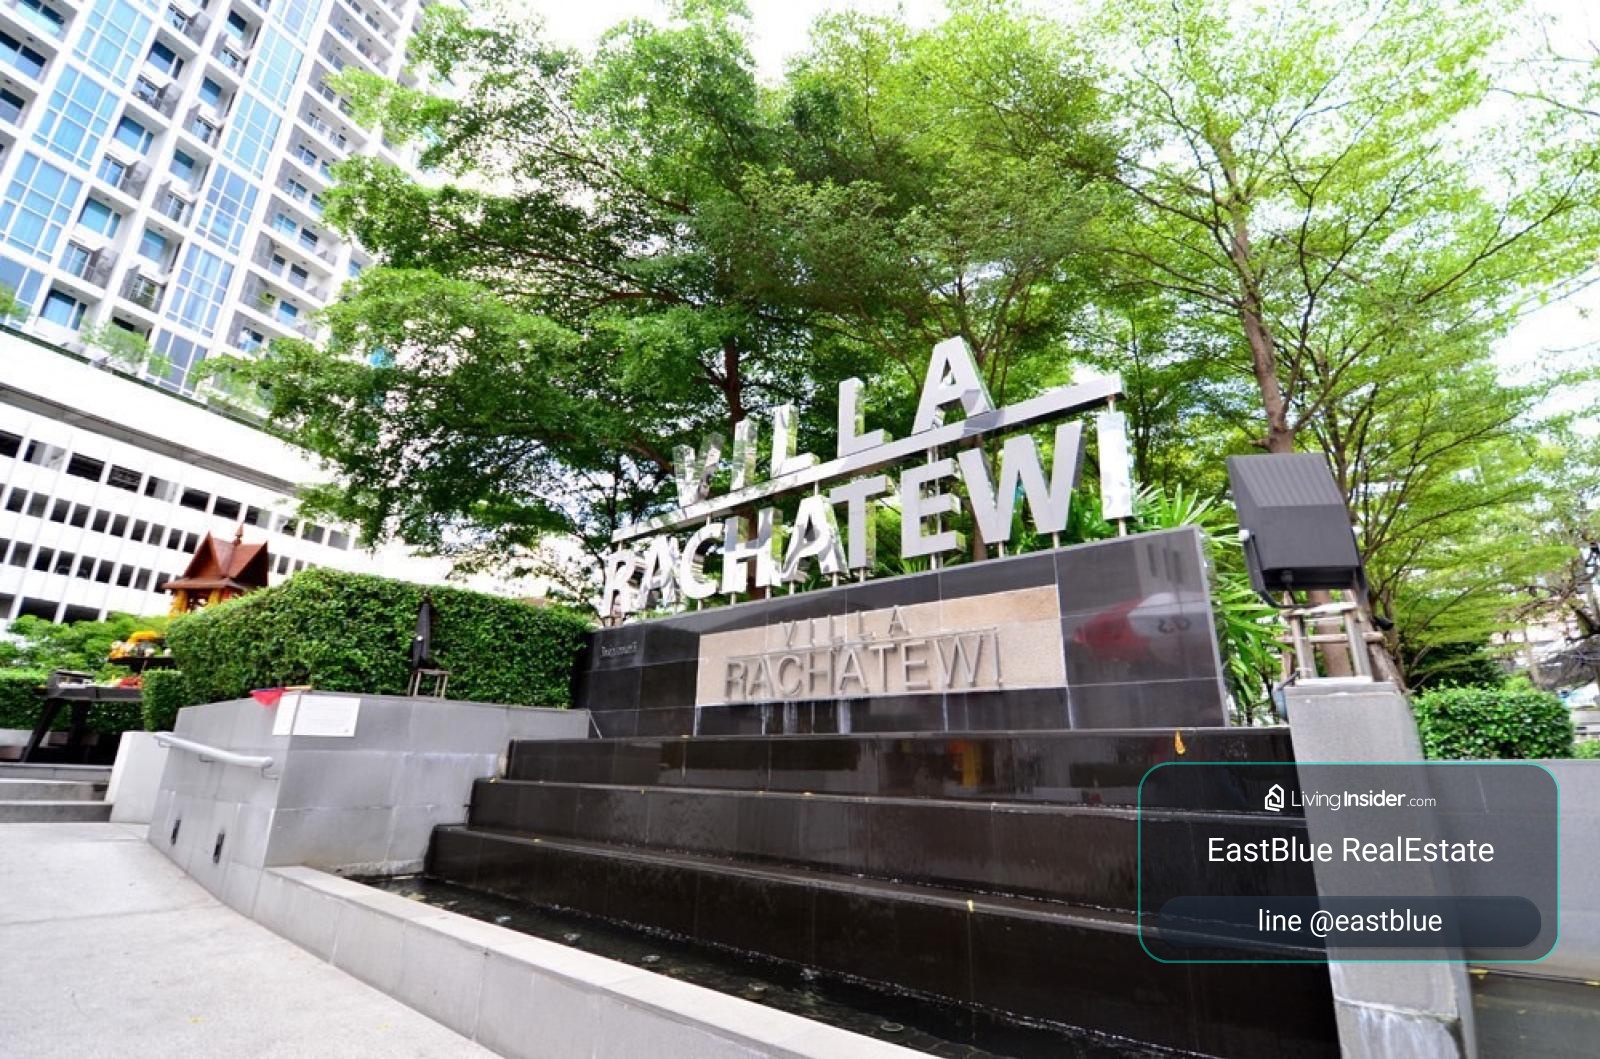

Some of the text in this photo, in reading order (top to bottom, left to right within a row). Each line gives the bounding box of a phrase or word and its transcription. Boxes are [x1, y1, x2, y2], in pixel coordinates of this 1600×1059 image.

[672, 336, 996, 508] VILLA
[597, 410, 1135, 618] RACHATEWI
[723, 628, 1003, 701] RACHATEWI
[780, 605, 912, 650] VILLA
